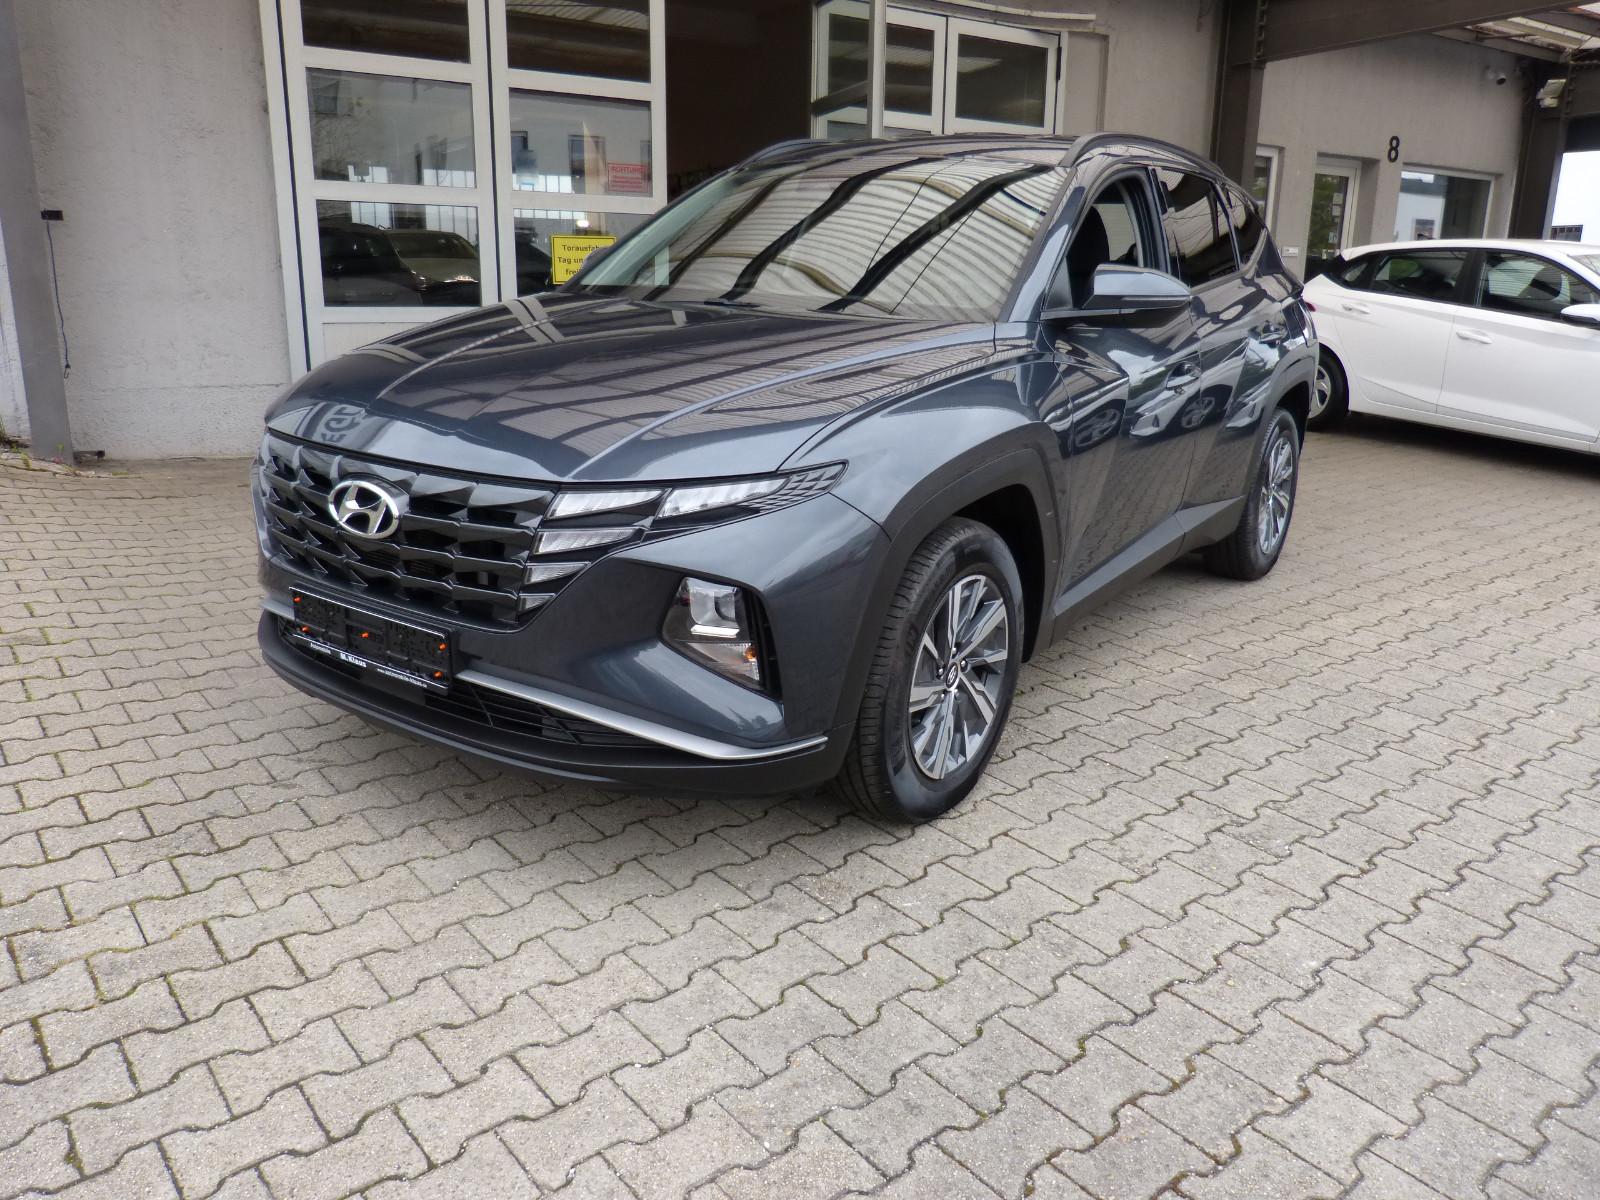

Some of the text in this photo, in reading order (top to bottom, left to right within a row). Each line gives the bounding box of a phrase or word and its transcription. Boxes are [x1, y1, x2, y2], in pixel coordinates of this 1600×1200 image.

[1388, 135, 1400, 163] 8
[557, 256, 572, 265] Tag
[348, 655, 368, 668] Klaus
